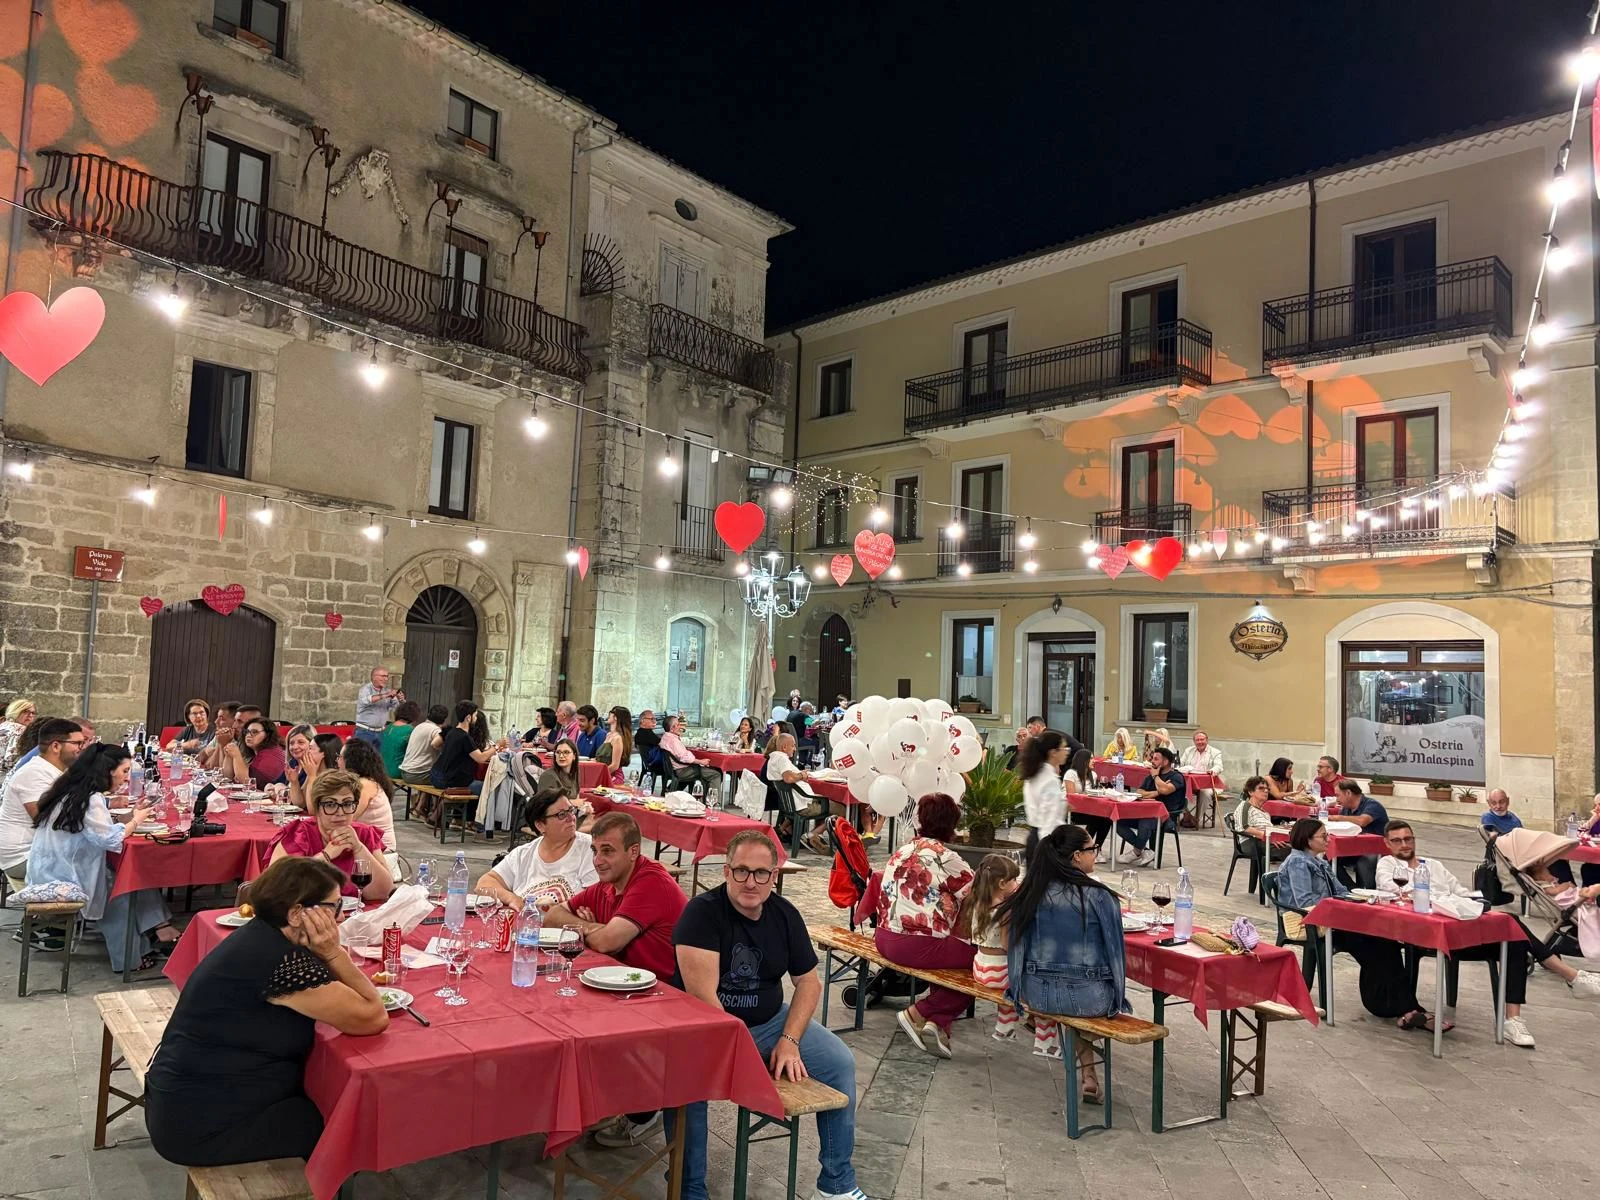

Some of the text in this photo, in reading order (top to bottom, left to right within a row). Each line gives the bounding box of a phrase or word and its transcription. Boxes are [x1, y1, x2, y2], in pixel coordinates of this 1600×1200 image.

[1238, 624, 1281, 636] Osteria
[1419, 738, 1464, 751] Osteria
[1409, 752, 1474, 768] Malaspina
[718, 991, 759, 1009] OSCHINO
